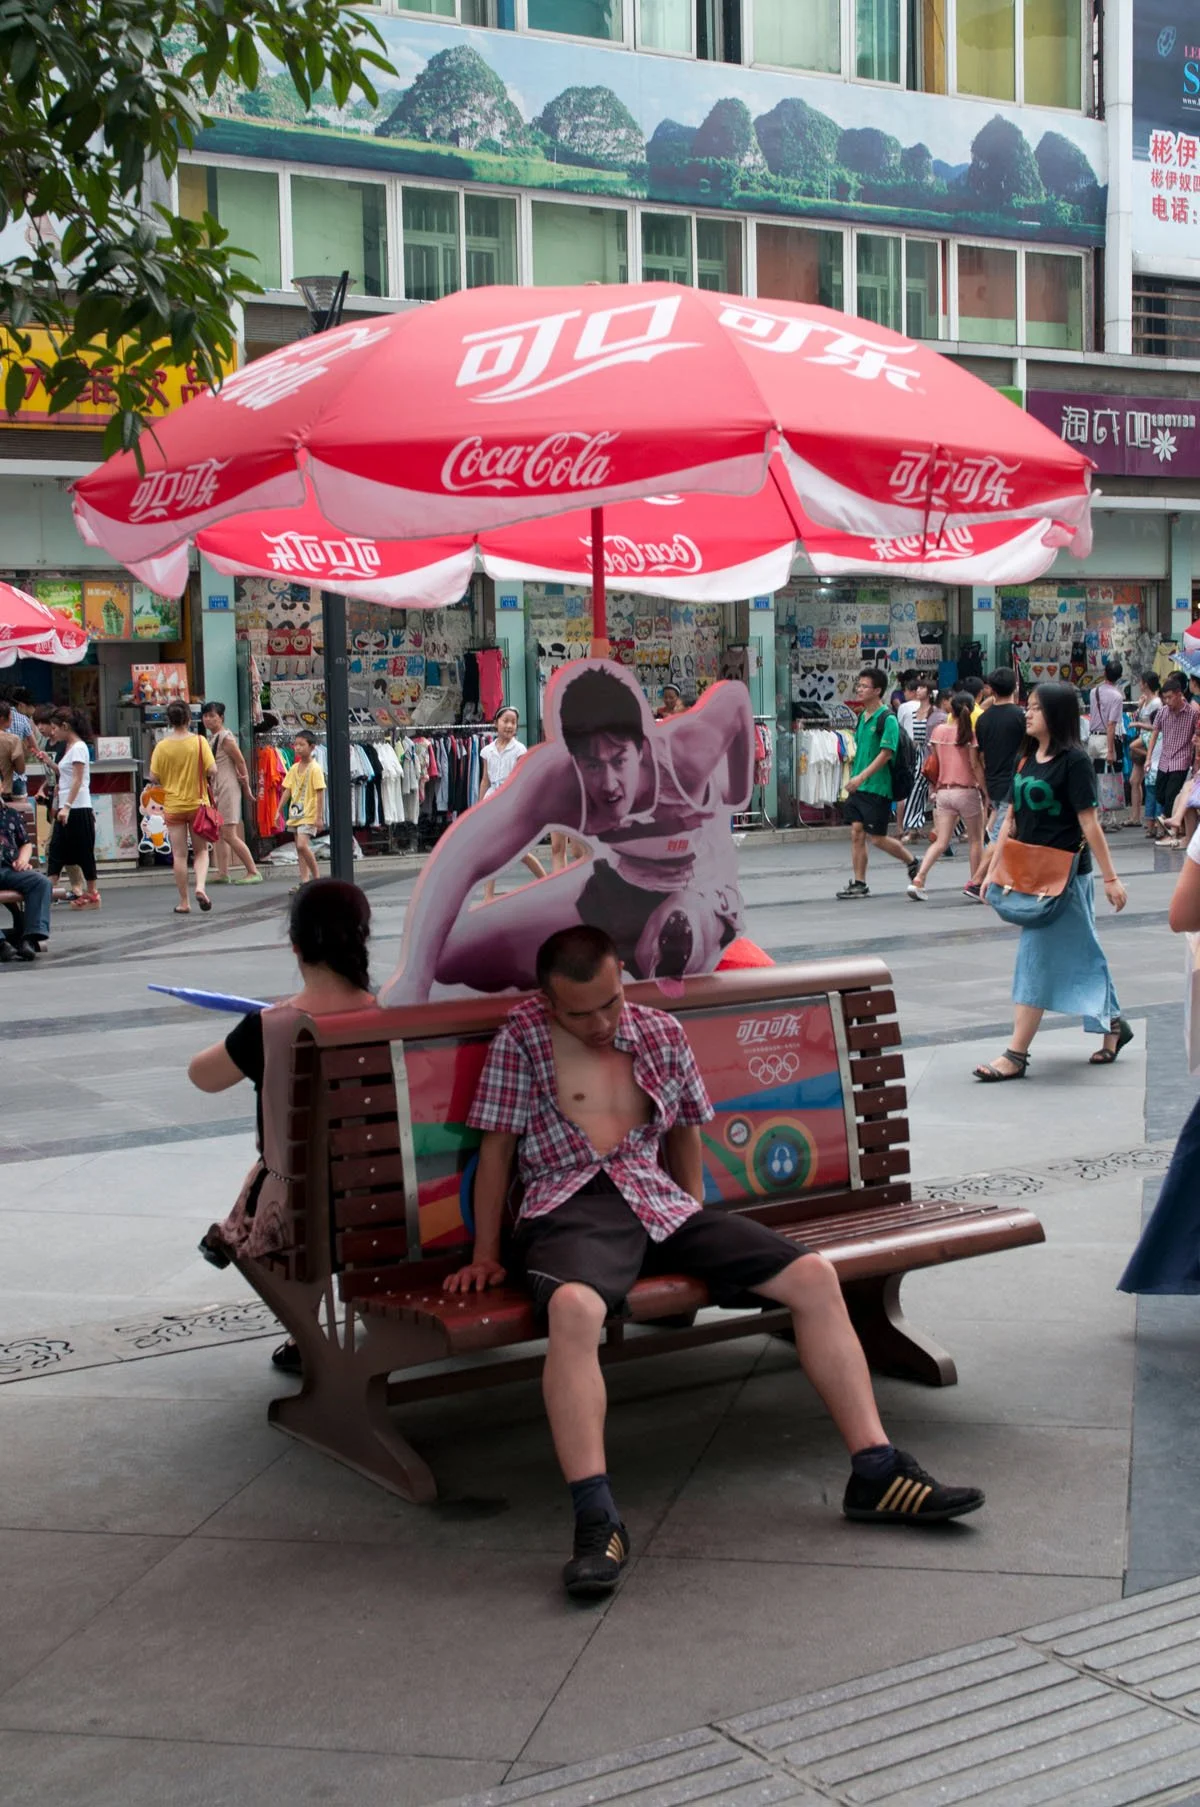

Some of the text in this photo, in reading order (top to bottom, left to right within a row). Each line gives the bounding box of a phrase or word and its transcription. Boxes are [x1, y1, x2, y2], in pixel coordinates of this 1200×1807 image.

[128, 457, 233, 523] 可口可乐
[441, 431, 622, 492] Coca-Cola
[736, 1013, 804, 1046] 可口可乐
